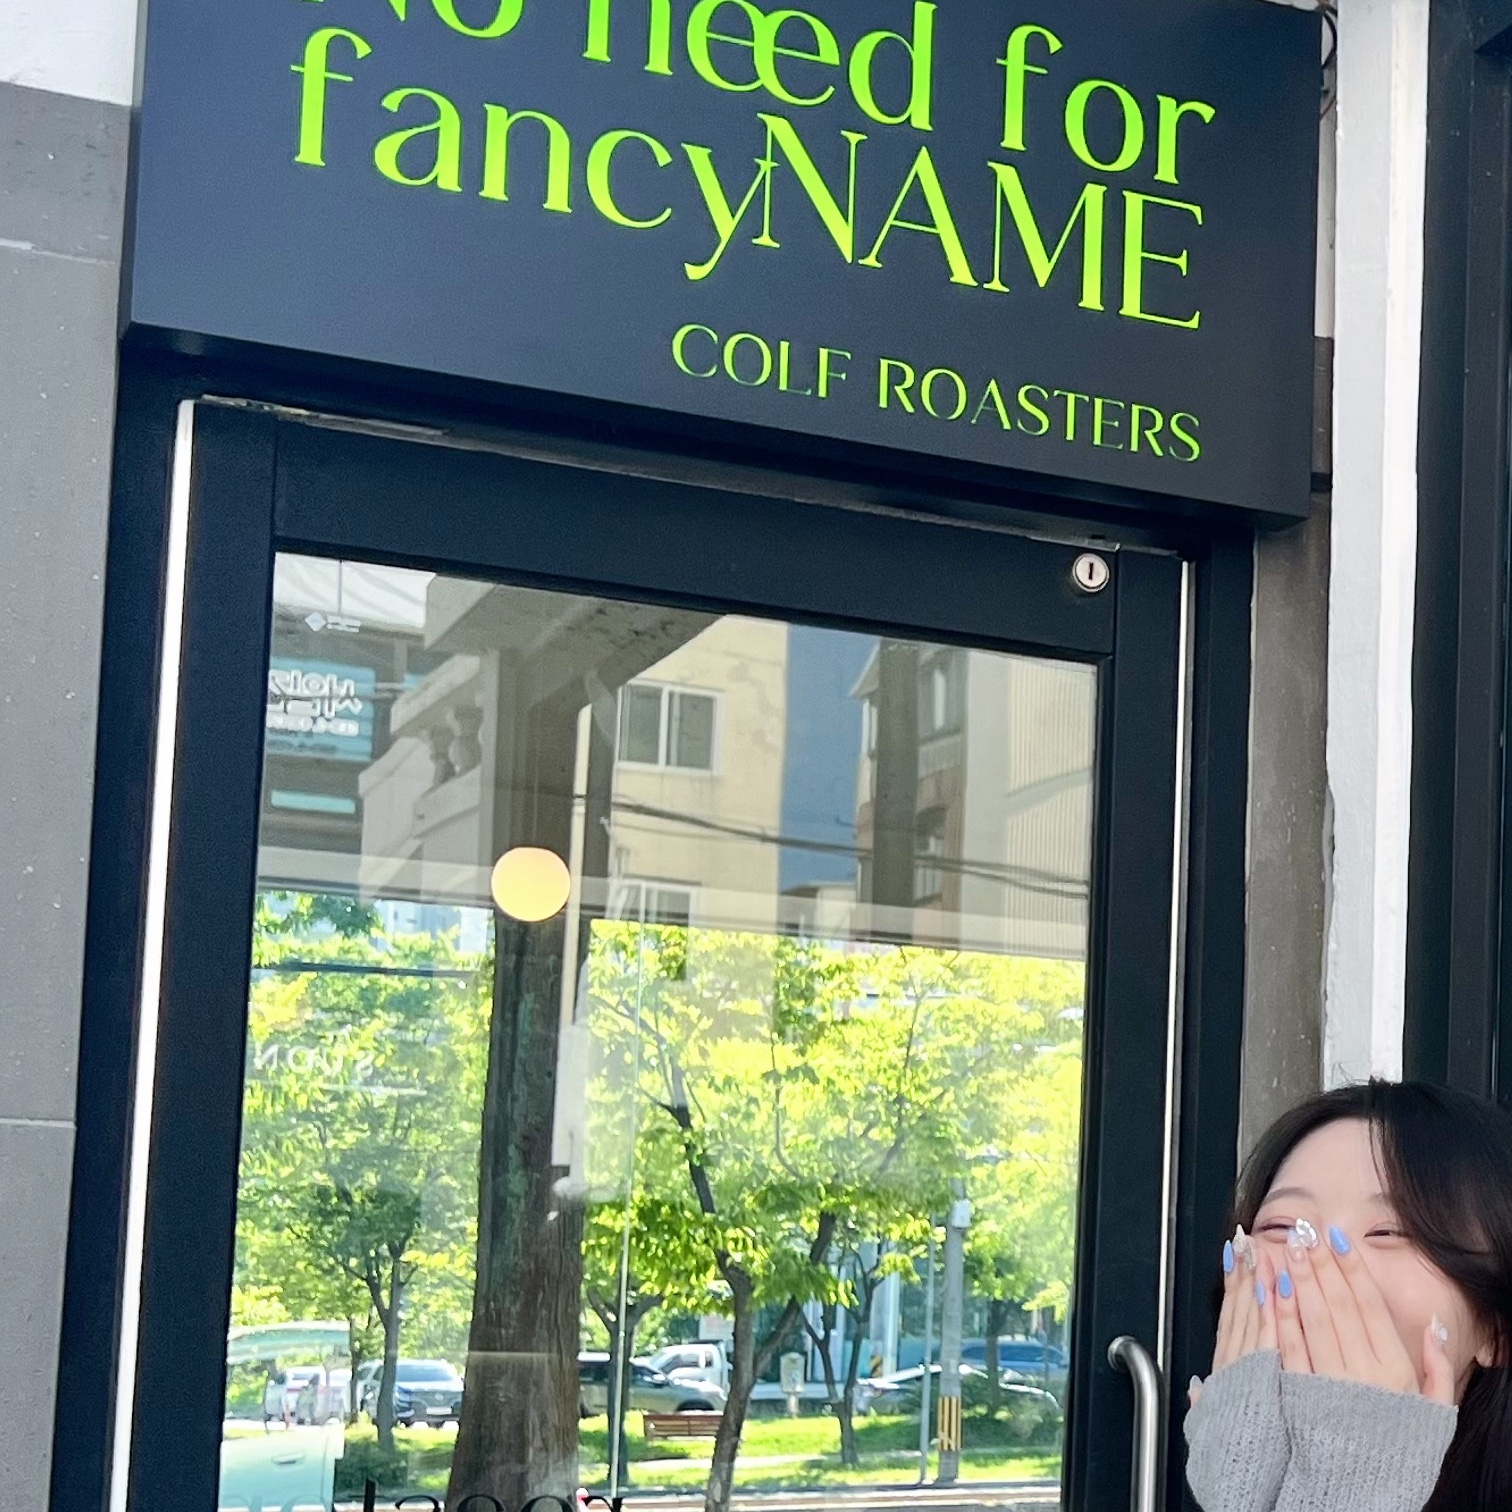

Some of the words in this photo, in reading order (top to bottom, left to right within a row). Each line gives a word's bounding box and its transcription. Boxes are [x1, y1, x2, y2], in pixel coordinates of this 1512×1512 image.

[582, 0, 938, 132] need
[995, 24, 1216, 186] for
[671, 323, 852, 399] COLF
[877, 356, 1200, 462] ROASTERS
